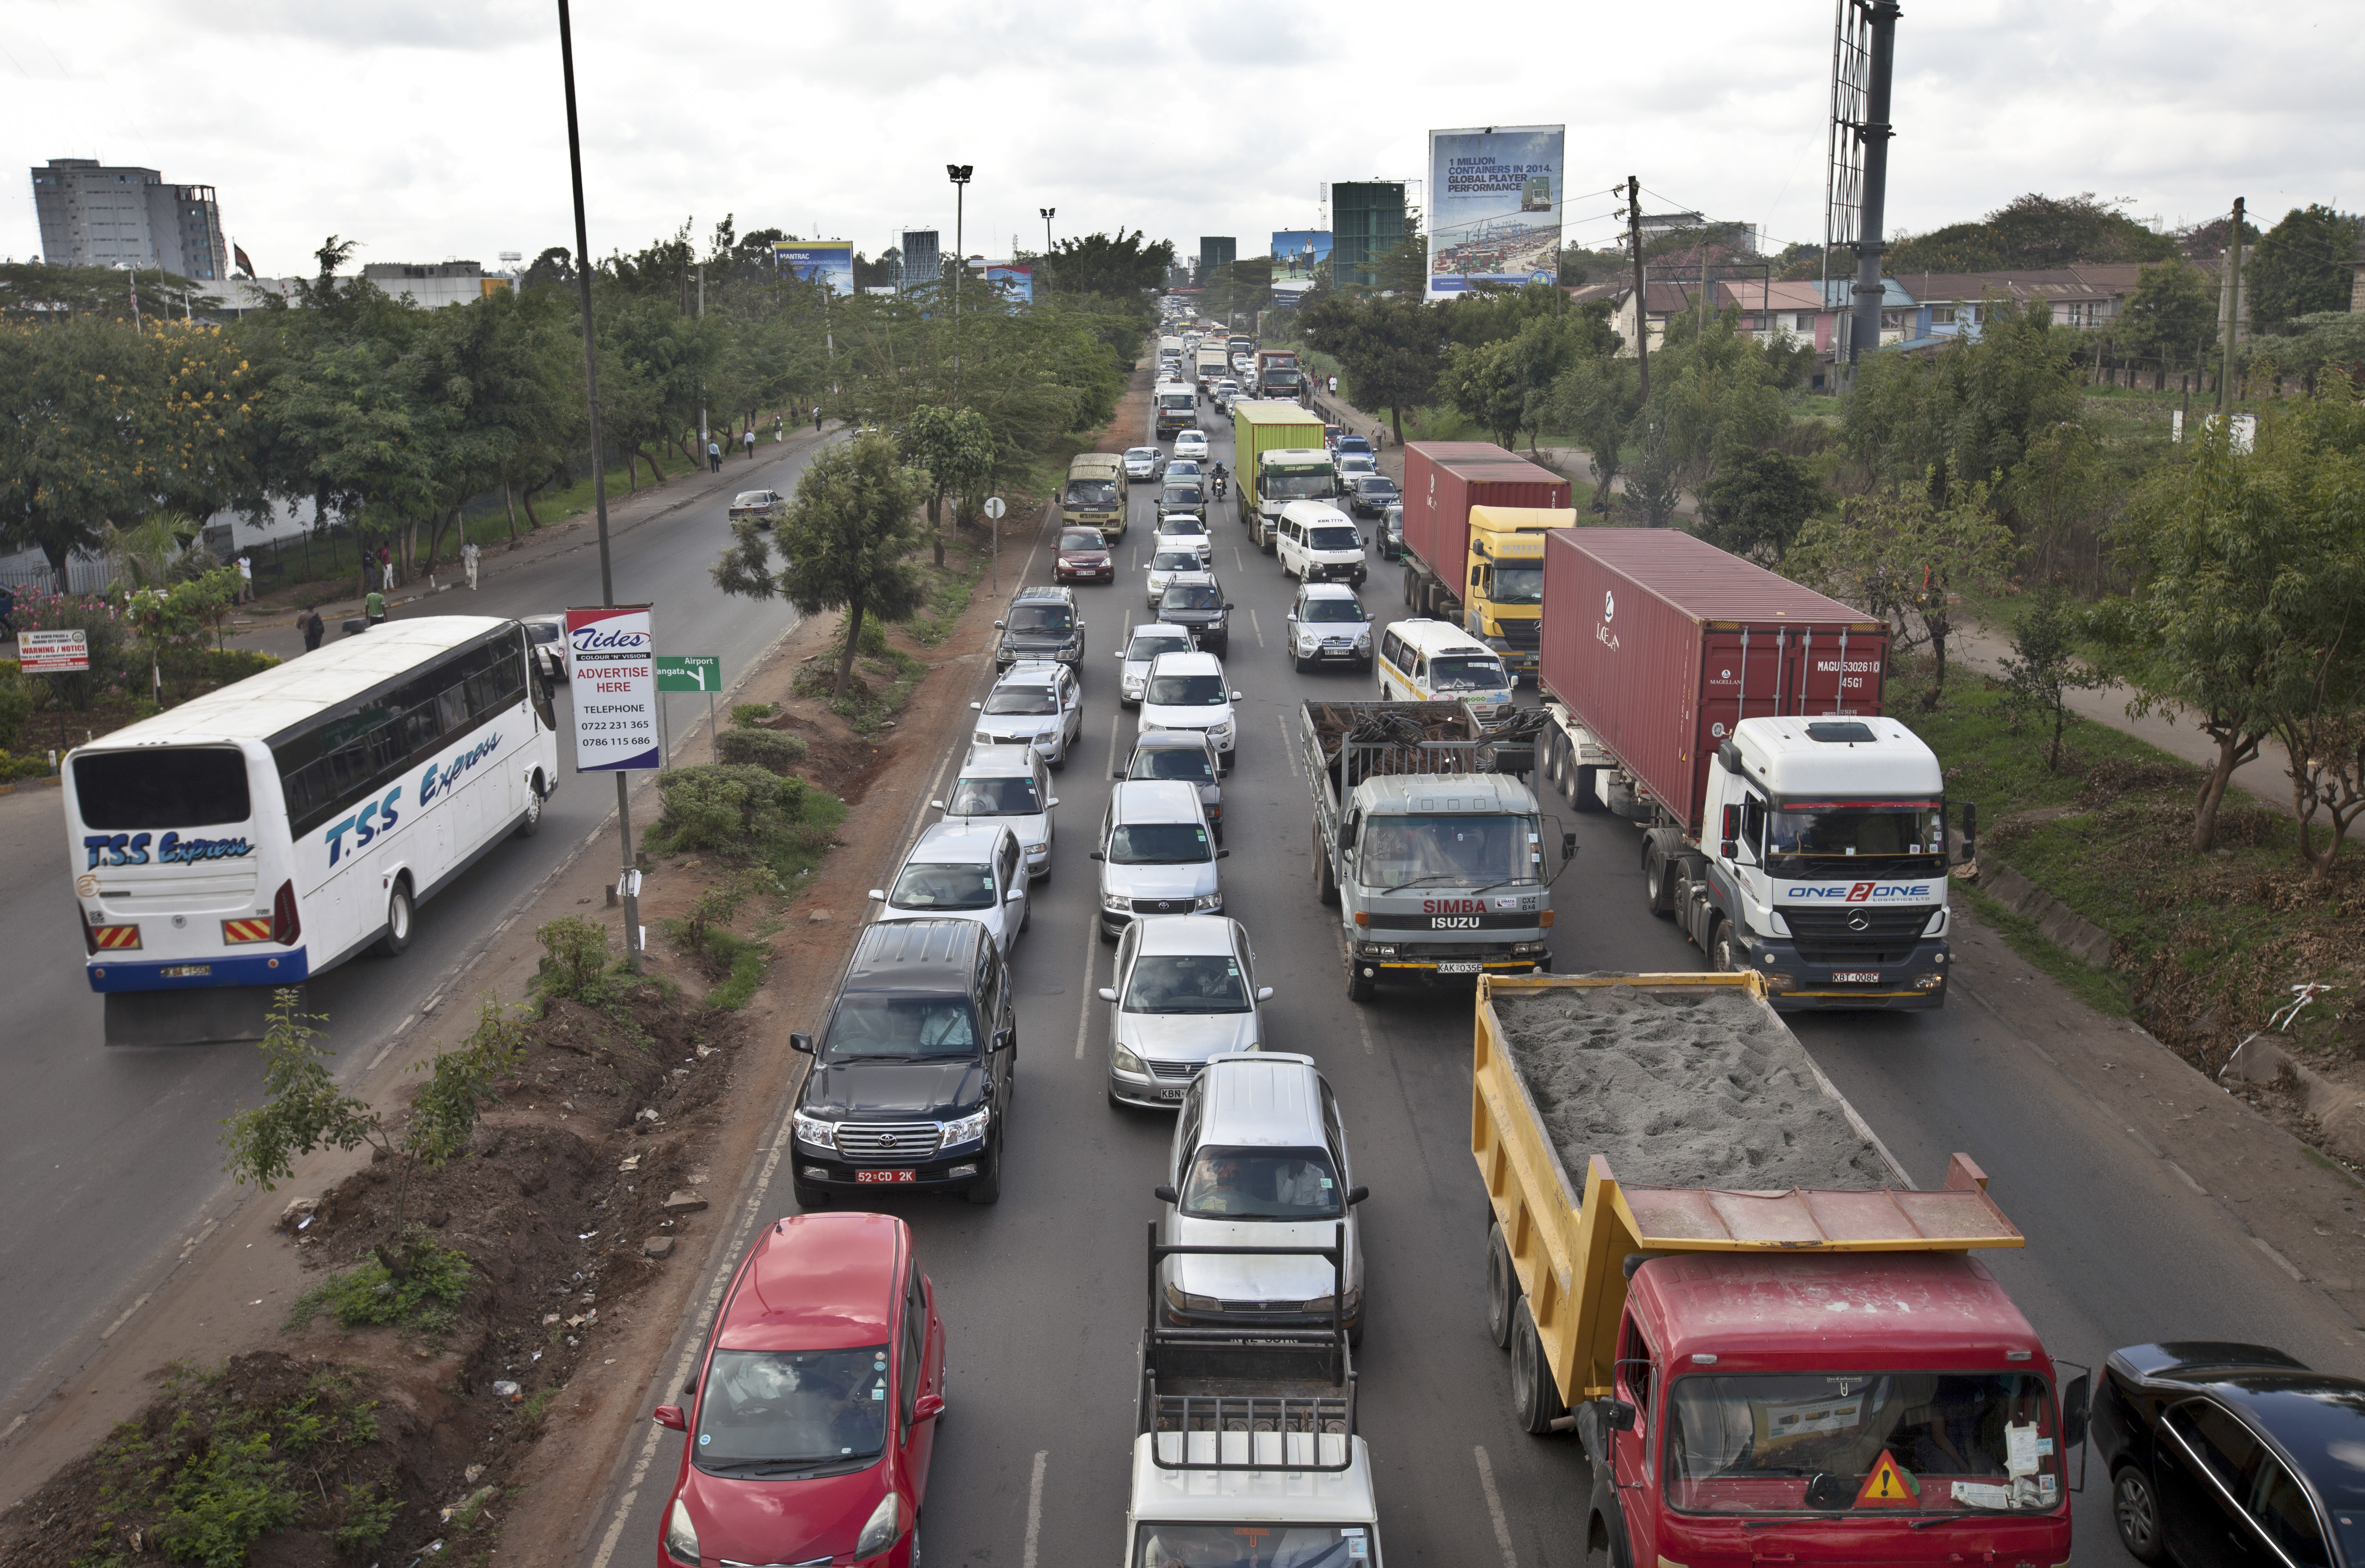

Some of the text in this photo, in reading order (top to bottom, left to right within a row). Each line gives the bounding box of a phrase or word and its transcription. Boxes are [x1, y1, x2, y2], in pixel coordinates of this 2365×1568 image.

[1457, 157, 1495, 166] MILLION
[1449, 165, 1511, 175] CONTAINERS
[1526, 164, 1552, 173] 2014.
[1448, 174, 1527, 184] GLOBAL PLAYER
[1448, 183, 1522, 192] PERFORMANCE
[573, 628, 644, 649] Tides
[22, 646, 55, 654] WARNING
[61, 644, 86, 653] NOTICE
[685, 657, 713, 666] Airport
[1818, 661, 1839, 672] MAGU
[577, 667, 649, 679] ADVERTISE
[597, 682, 631, 693] HERE
[1842, 677, 1863, 688] 45G1
[583, 704, 645, 714] TELEPHONE
[582, 722, 606, 730] 0722
[609, 721, 626, 729] 231
[583, 739, 608, 747] 0786
[631, 737, 650, 745] 686
[326, 732, 503, 869] T.S.S Express
[84, 832, 256, 872] T.S.S Express
[1423, 899, 1488, 914] SIMBA
[1432, 917, 1480, 928] ISUZU
[1438, 963, 1482, 972] KAK 035E
[1834, 973, 1878, 982] KBT 008C
[1162, 1090, 1181, 1098] KBN
[858, 1172, 913, 1182] 52 CD 2K
